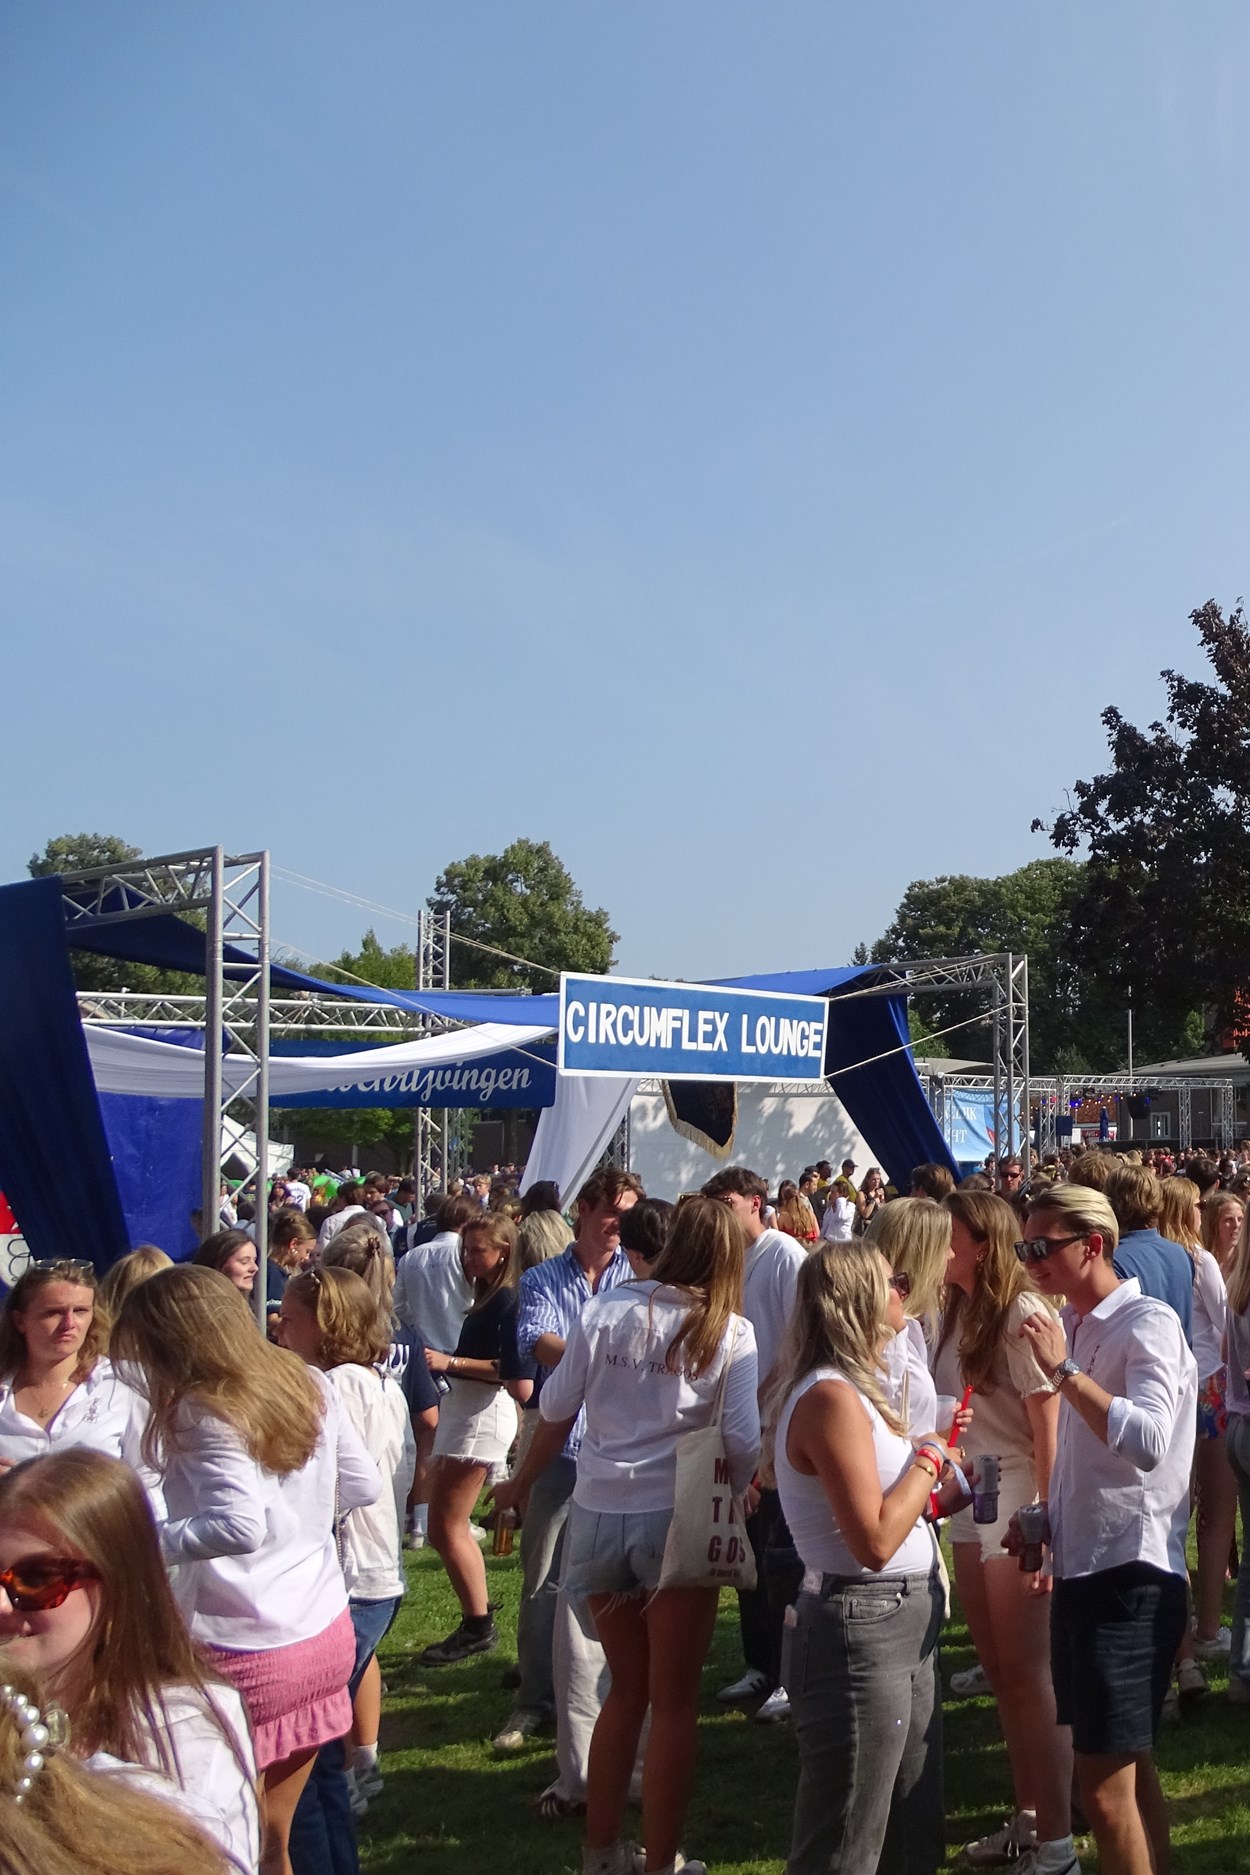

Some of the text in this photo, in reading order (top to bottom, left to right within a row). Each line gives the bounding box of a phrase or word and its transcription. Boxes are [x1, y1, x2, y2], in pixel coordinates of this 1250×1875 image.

[566, 1000, 824, 1058] CIRCUMFLEX LOUNGE
[605, 1353, 644, 1372] M.S.V.
